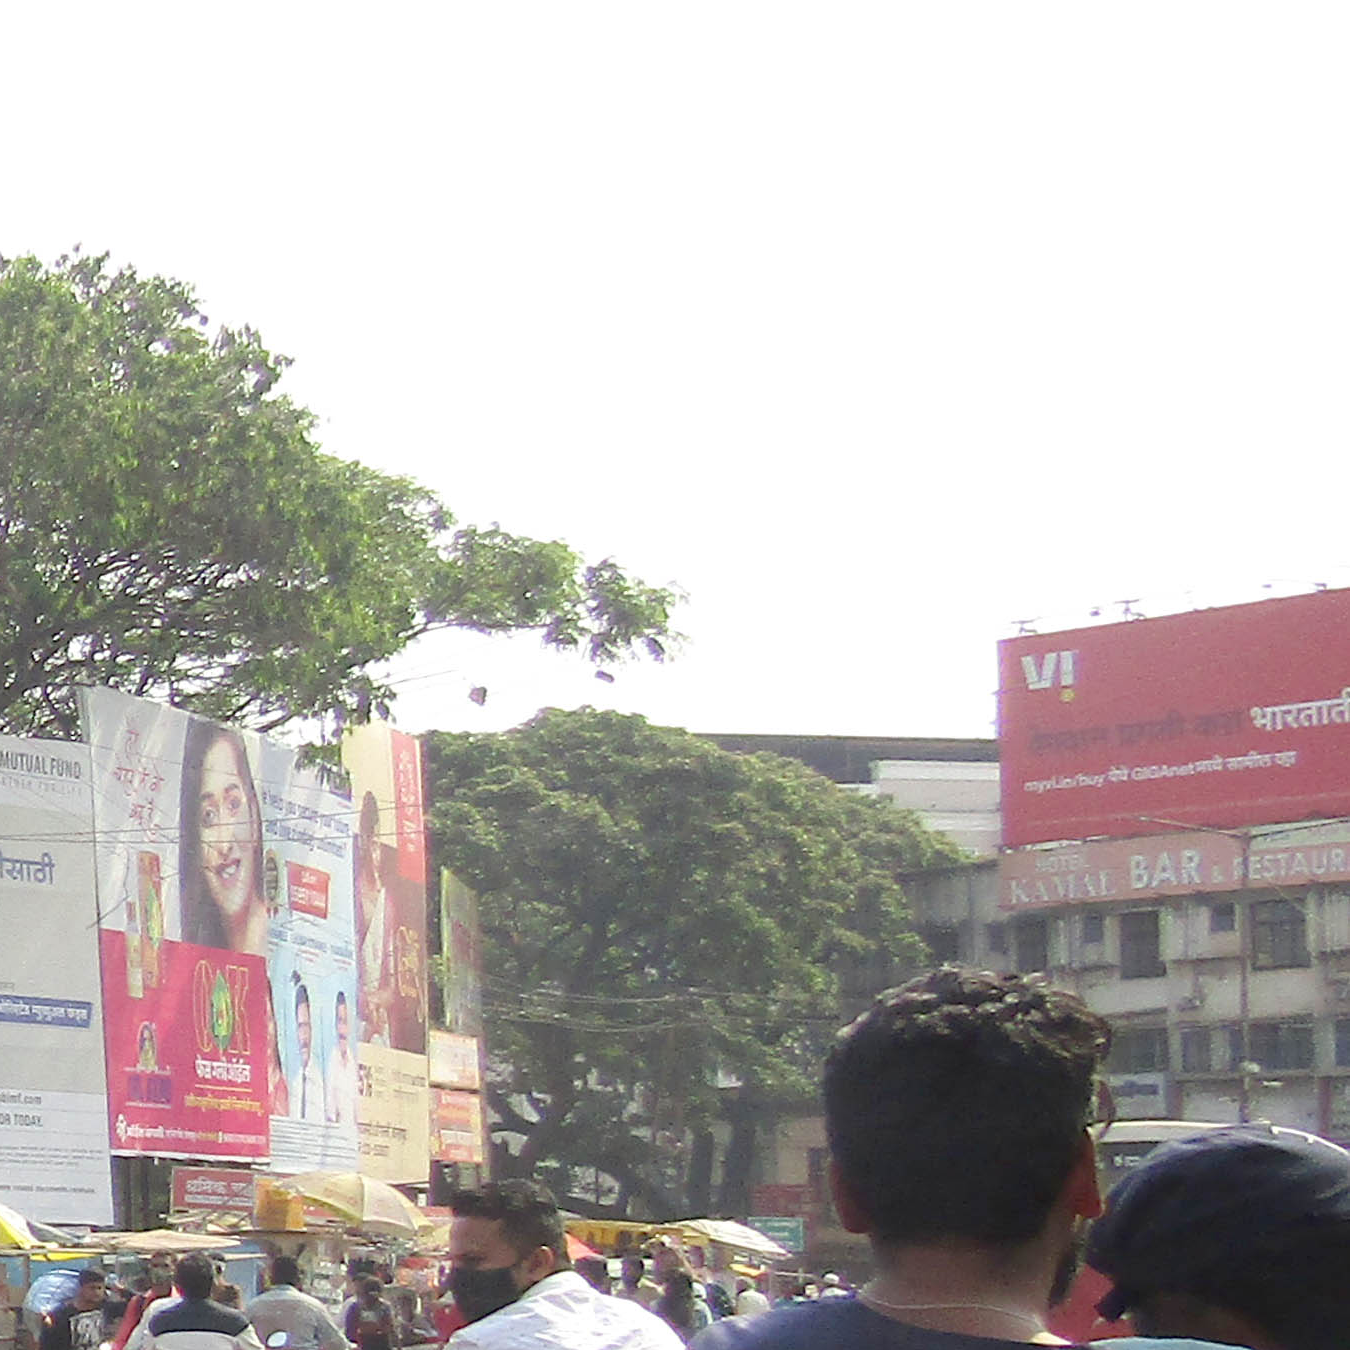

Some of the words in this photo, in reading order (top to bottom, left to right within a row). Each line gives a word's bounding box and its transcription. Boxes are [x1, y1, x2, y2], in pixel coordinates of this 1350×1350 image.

[50, 757, 82, 779] FUND
[1129, 850, 1201, 889] BAR
[1234, 848, 1350, 880] RESTAUR
